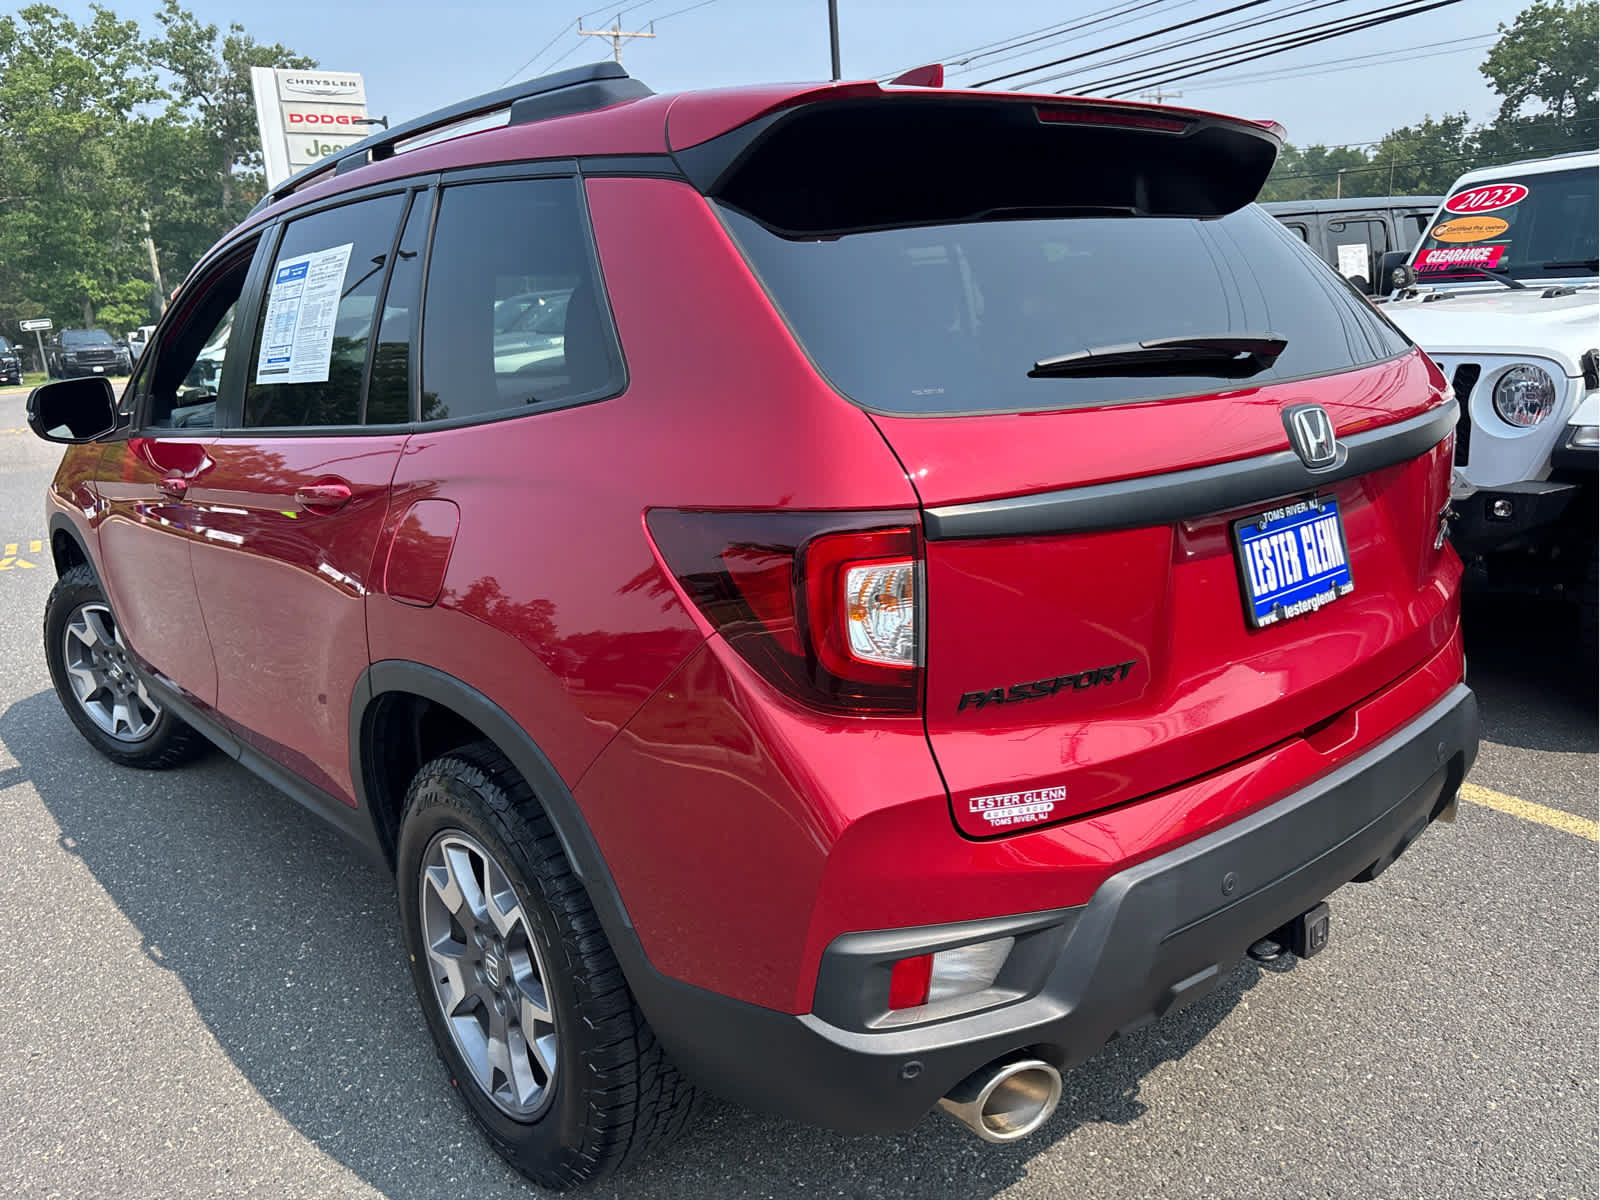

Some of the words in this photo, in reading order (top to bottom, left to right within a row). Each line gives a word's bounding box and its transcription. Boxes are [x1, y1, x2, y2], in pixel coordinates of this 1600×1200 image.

[286, 78, 357, 87] CHRYSLER
[1455, 187, 1517, 210] 2023
[1426, 248, 1493, 263] CLEARANCE
[1263, 509, 1284, 523] TOMS
[1309, 499, 1319, 509] NJ
[1244, 530, 1303, 597] LESTER
[1300, 516, 1344, 577] GLENN
[957, 660, 1138, 712] PASSPORT
[970, 795, 1020, 810] LESTER
[1023, 787, 1066, 802] GLENN
[986, 809, 1014, 817] AUTO
[991, 818, 1012, 826] TOMS
[1038, 812, 1048, 820] NJ
